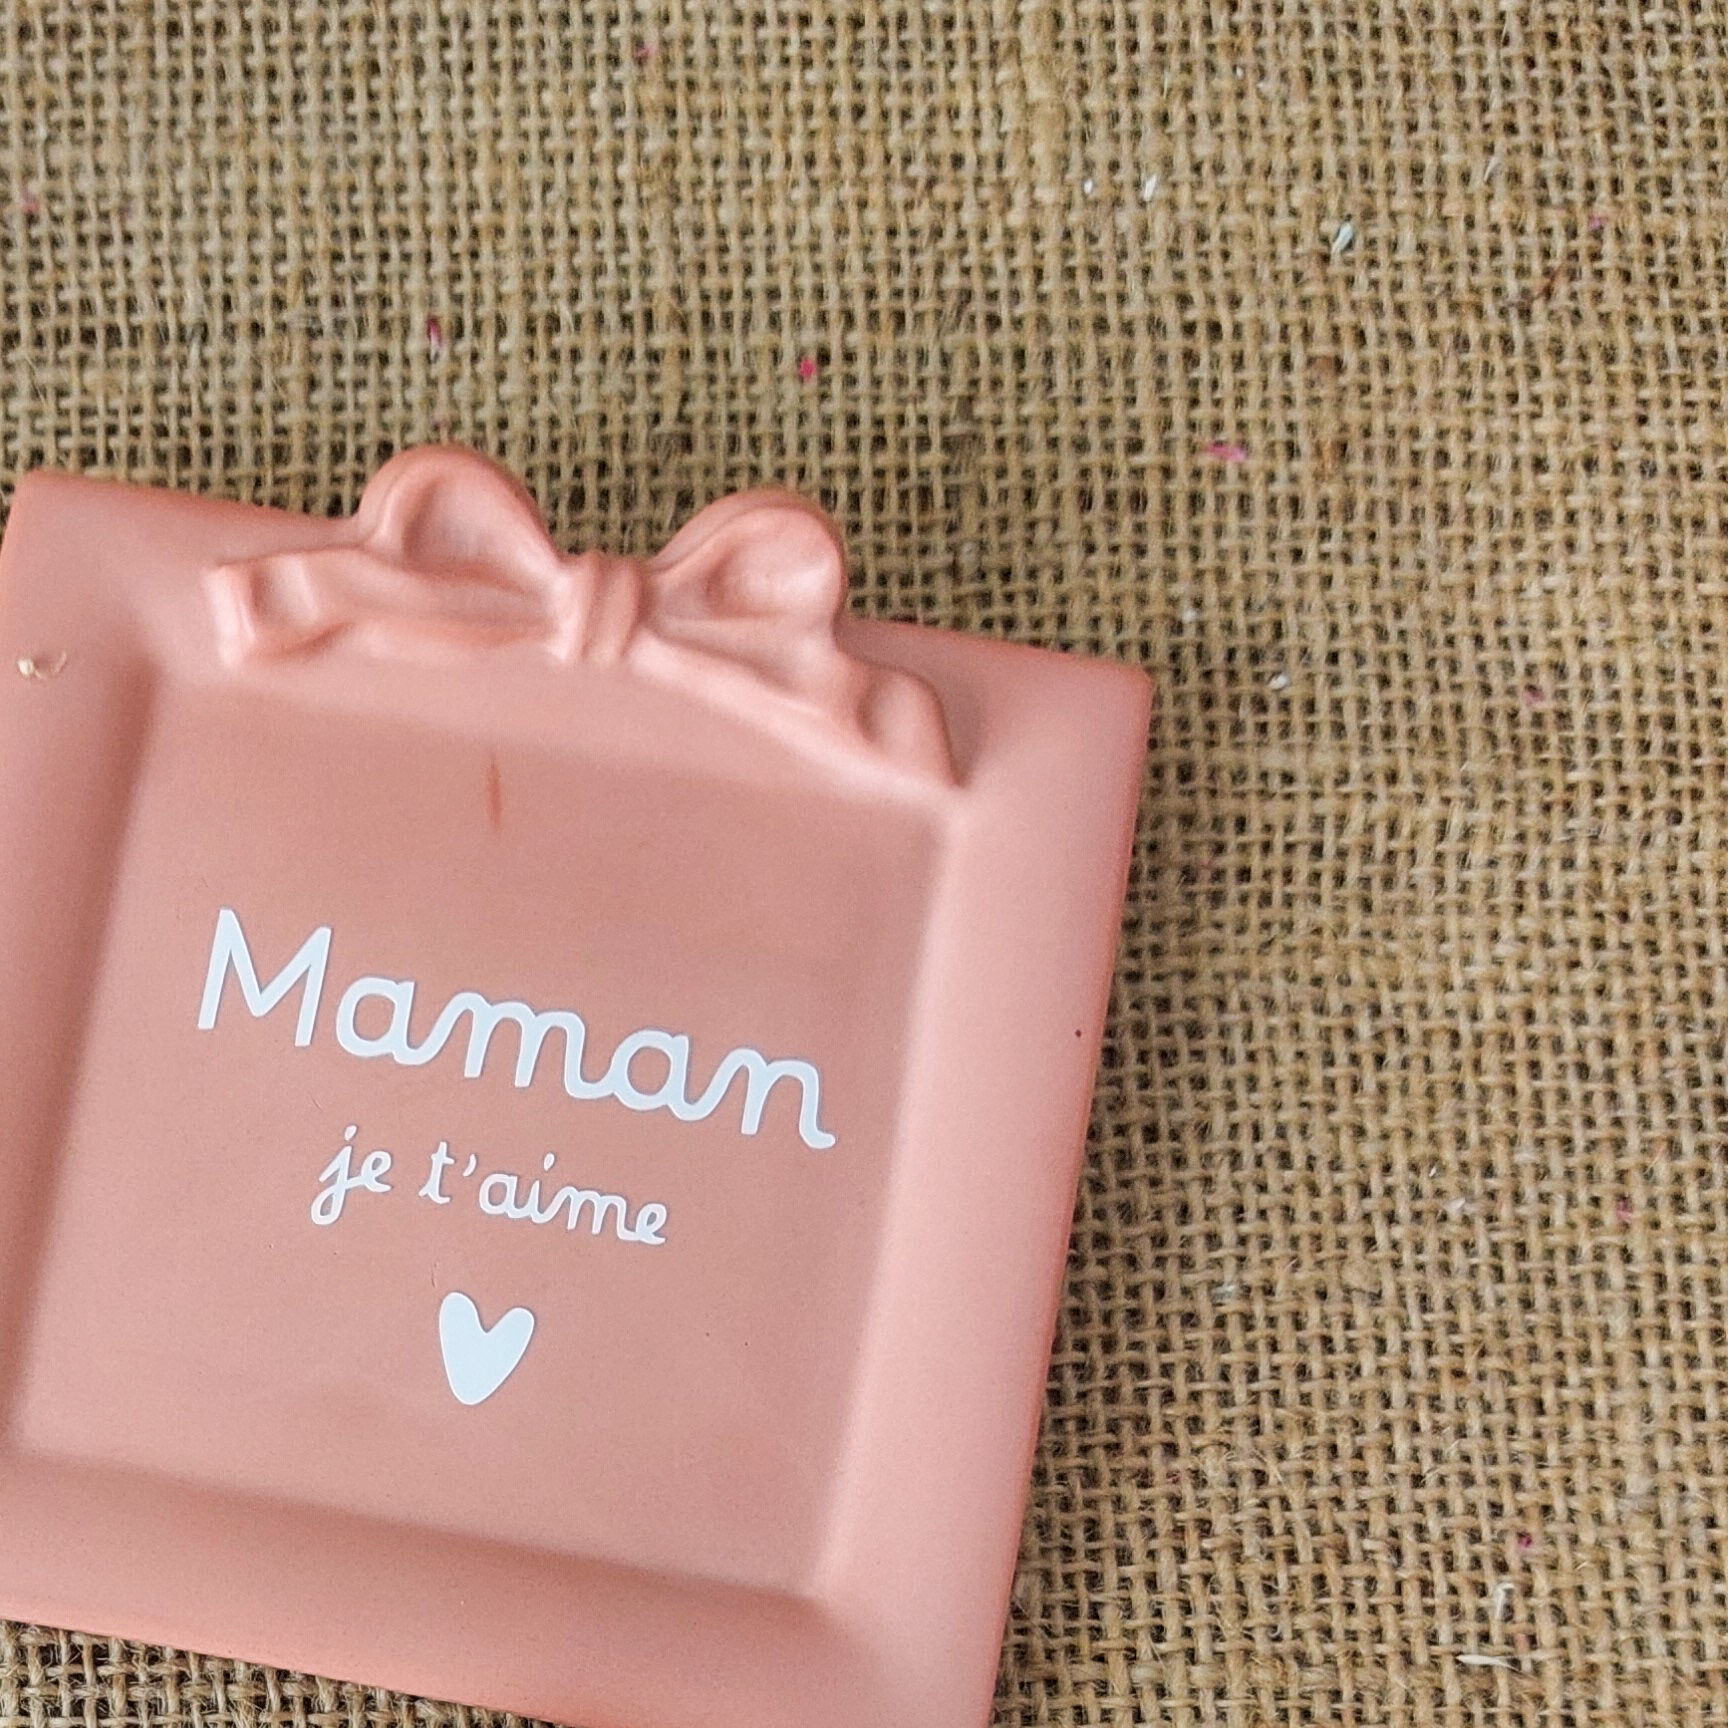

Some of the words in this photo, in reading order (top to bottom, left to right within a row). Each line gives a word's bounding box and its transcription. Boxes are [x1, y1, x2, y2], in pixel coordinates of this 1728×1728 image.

[198, 908, 835, 1149] Maman
[311, 1125, 392, 1225] je
[419, 1141, 667, 1244] t'aime
